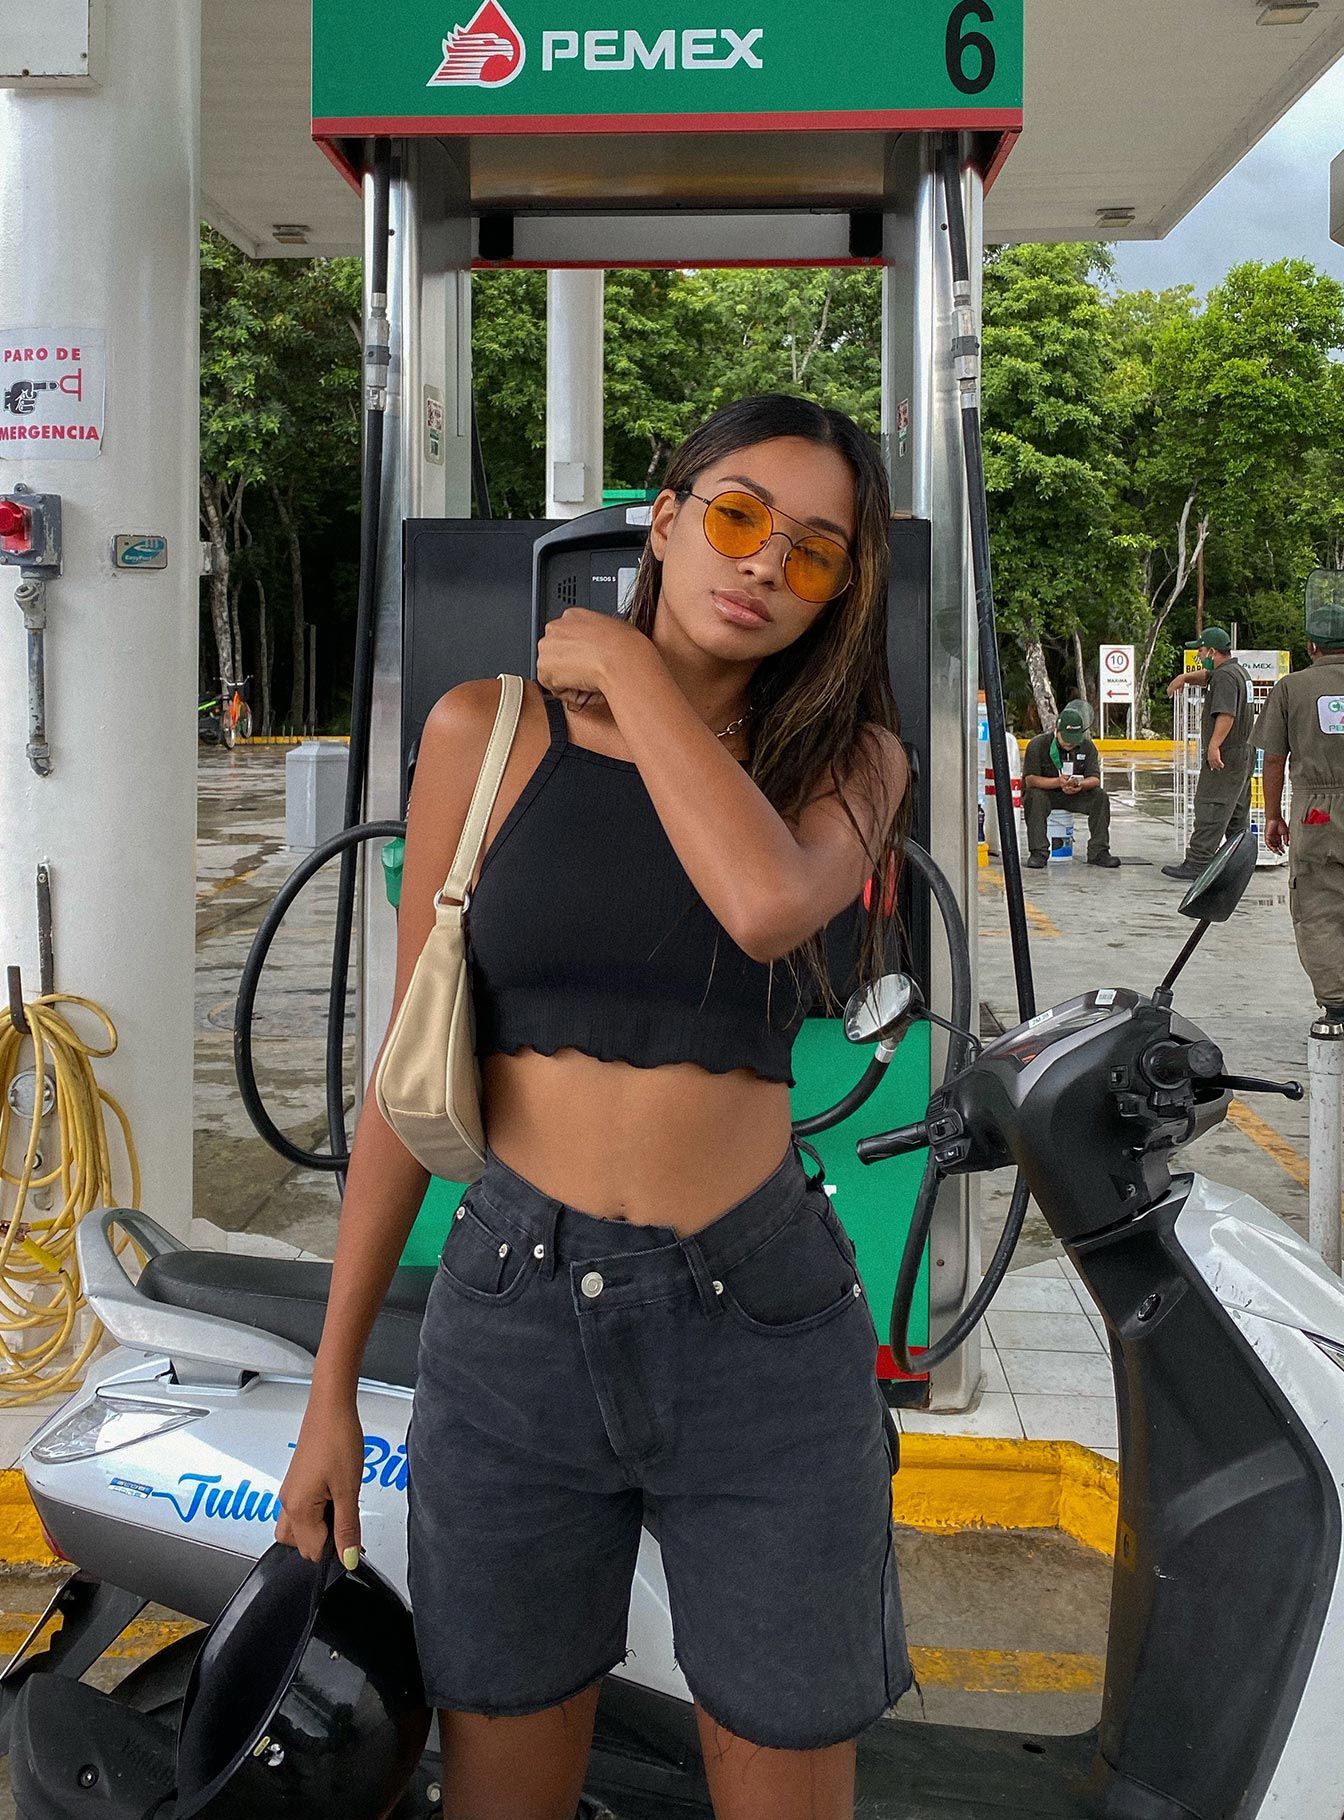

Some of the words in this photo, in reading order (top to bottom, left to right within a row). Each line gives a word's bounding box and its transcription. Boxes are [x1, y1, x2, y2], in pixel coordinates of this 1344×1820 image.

[542, 29, 763, 71] PEMEX
[945, 0, 996, 95] 6
[4, 347, 48, 362] PARO
[56, 347, 81, 361] DE
[0, 425, 100, 441] MERGENCIA
[1111, 655, 1124, 665] 10
[1185, 664, 1204, 674] BAR
[362, 1436, 408, 1491] Bi
[152, 1473, 282, 1523] Tulu
